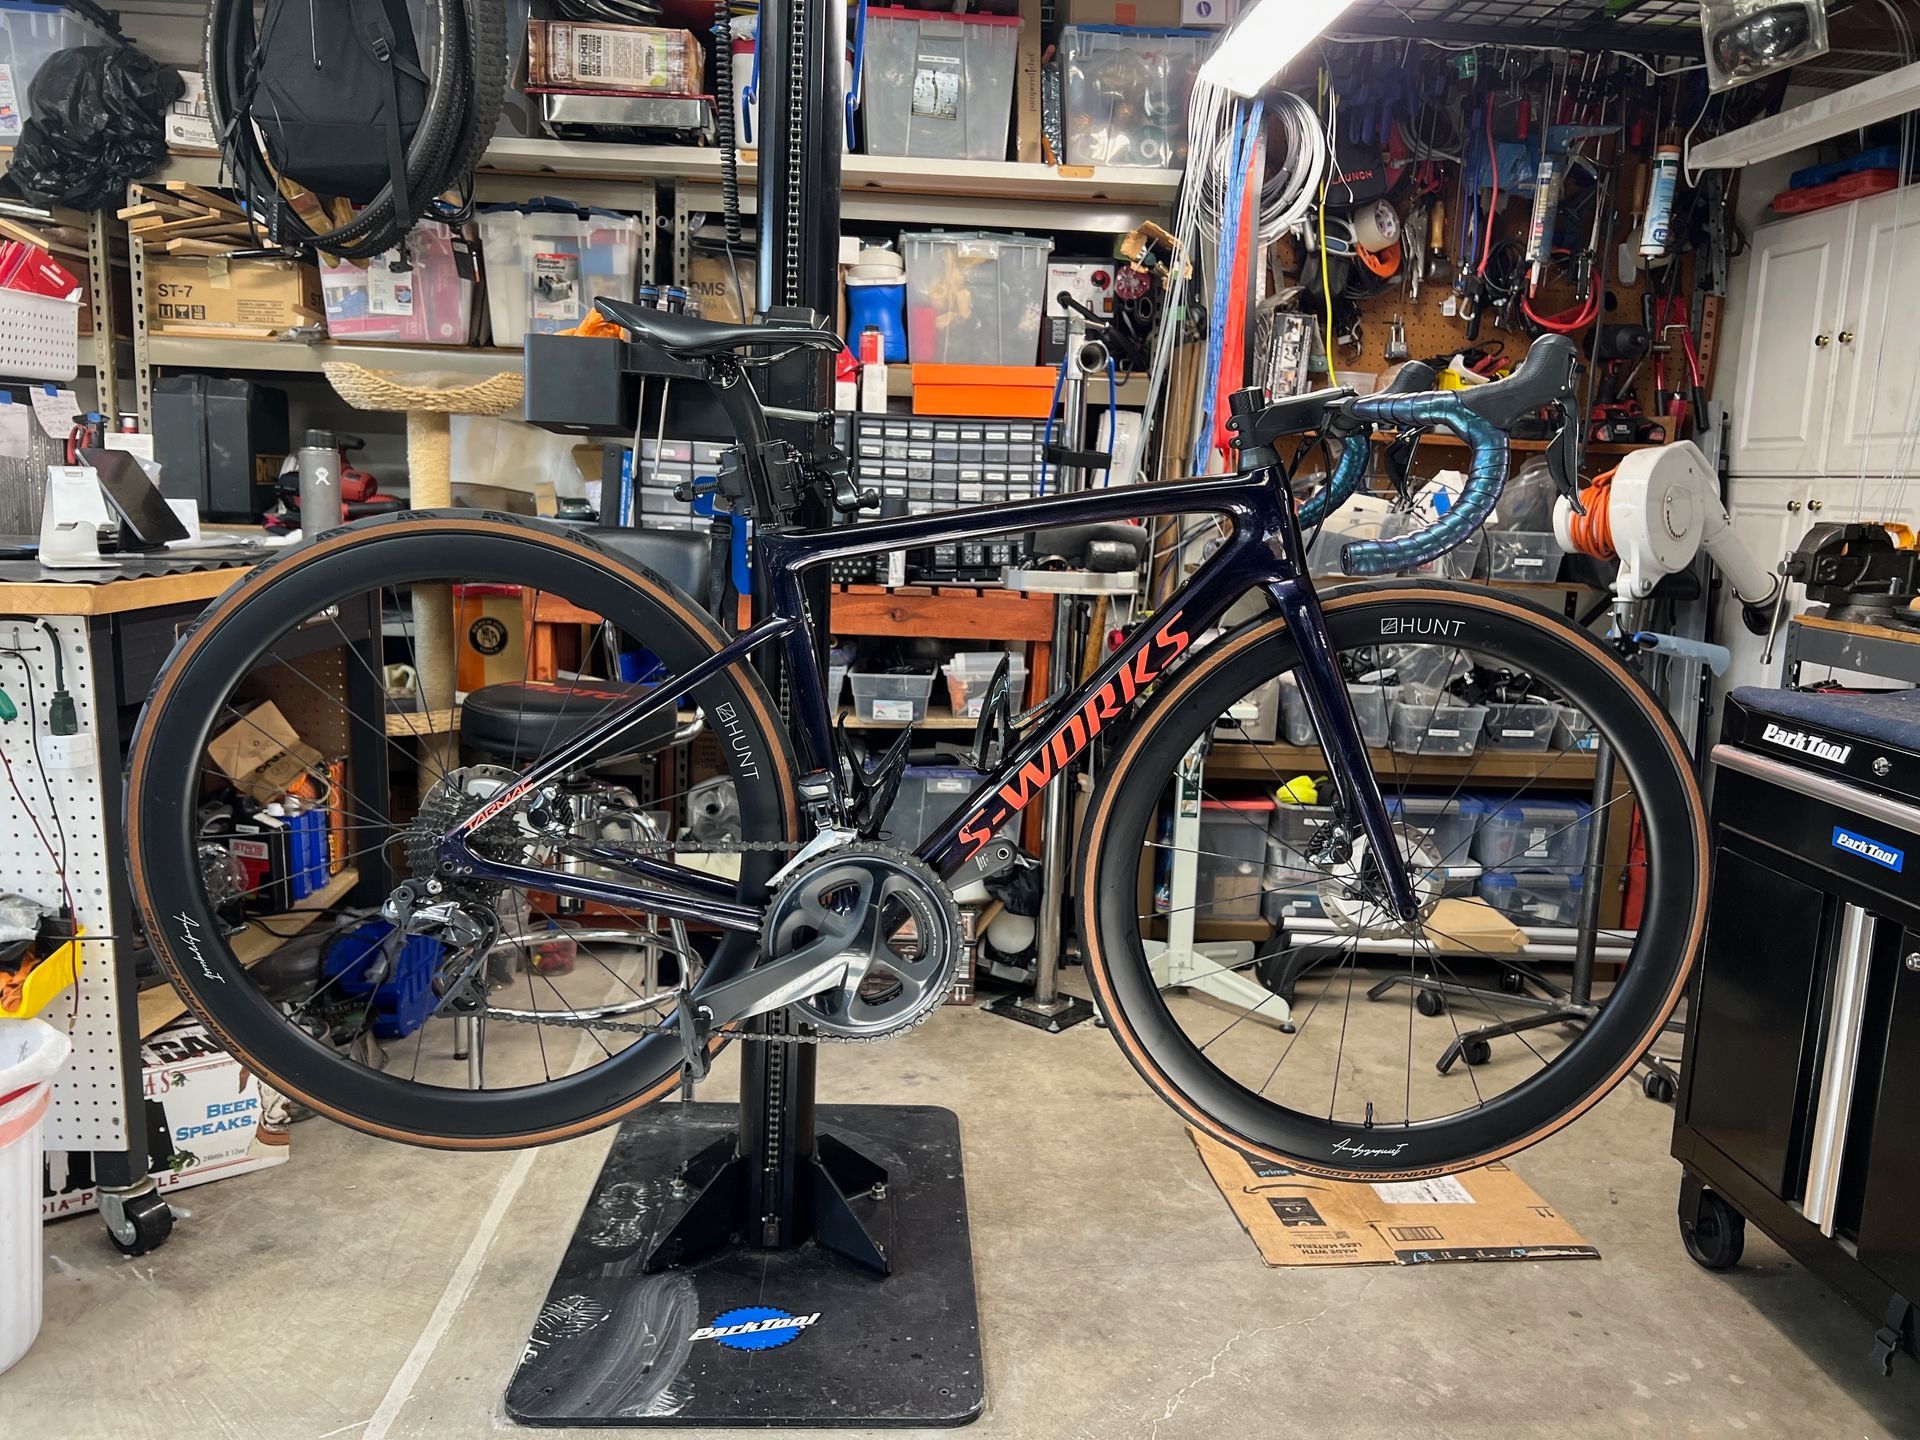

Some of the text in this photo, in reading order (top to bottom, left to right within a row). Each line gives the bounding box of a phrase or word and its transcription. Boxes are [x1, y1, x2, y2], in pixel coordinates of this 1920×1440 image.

[580, 34, 588, 75] SUMMER
[158, 284, 193, 297] ST-7
[1400, 617, 1466, 637] HUNT
[958, 610, 1189, 862] S-WORKS
[724, 719, 760, 780] HUNT
[464, 777, 534, 830] TARMAC
[206, 1097, 258, 1119] BEER
[175, 1115, 257, 1142] SPEAKS.
[1258, 1168, 1290, 1177] prime
[1308, 1166, 1353, 1179] 5000
[1355, 1171, 1391, 1179] PRIX
